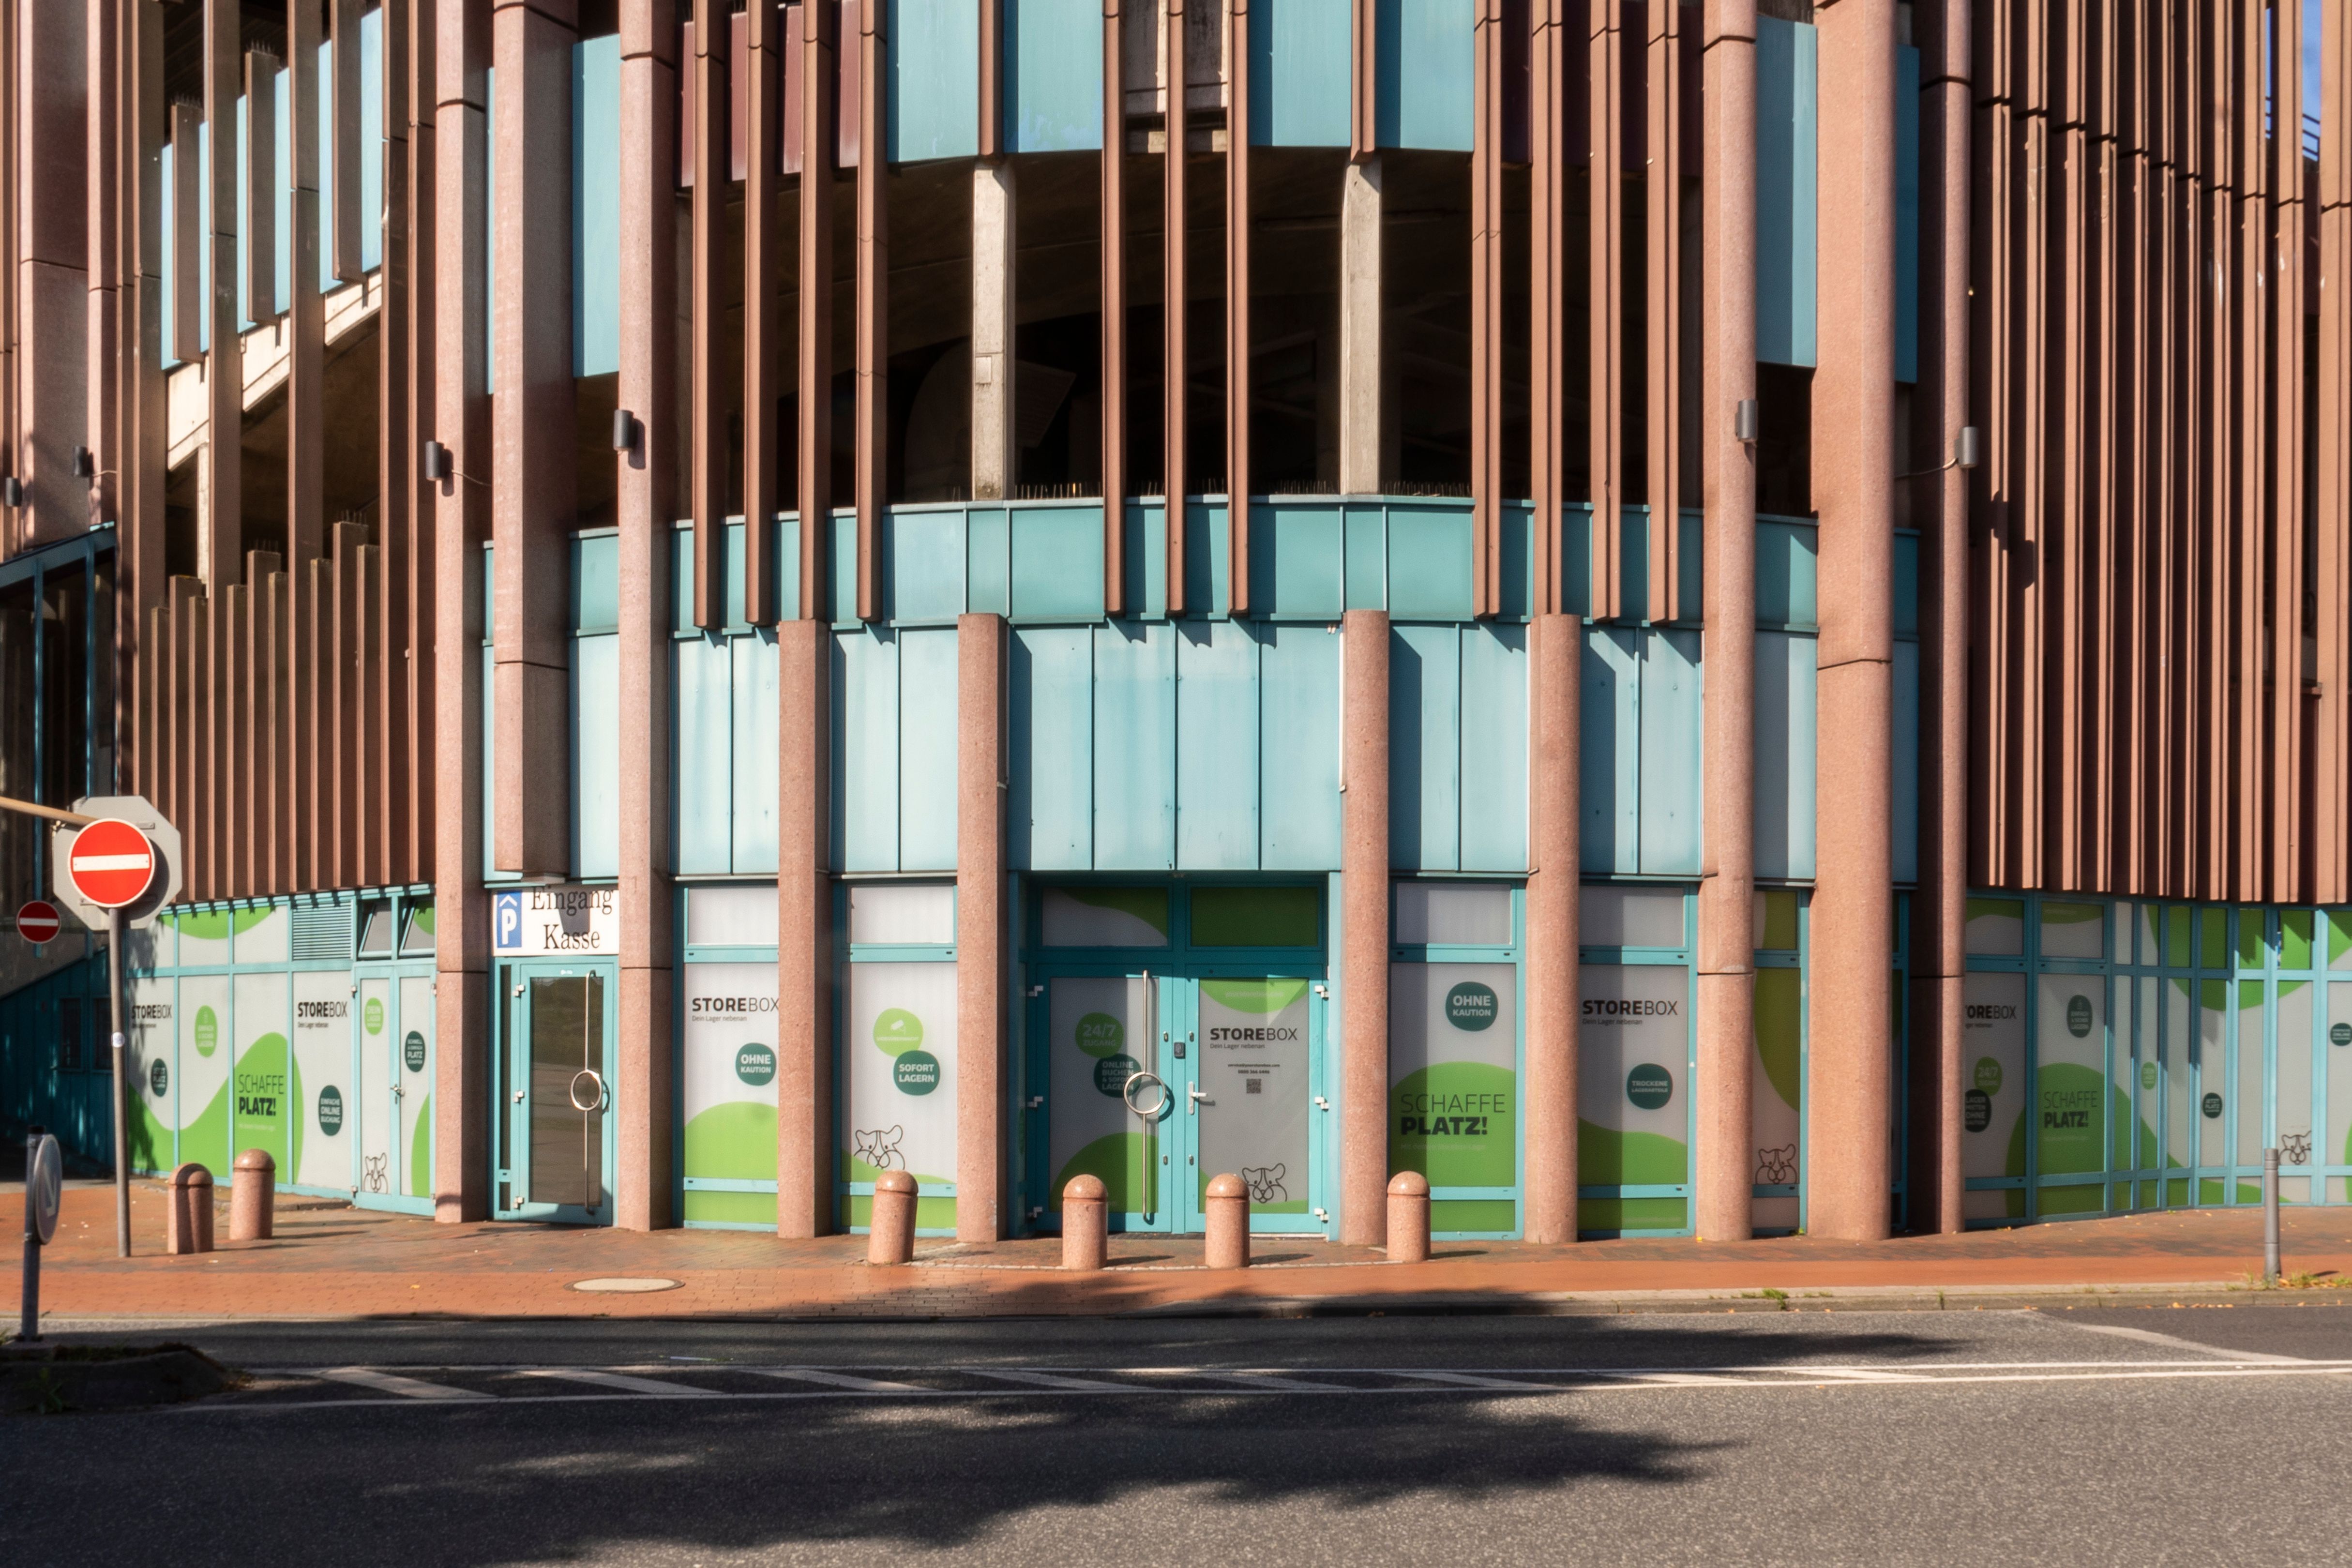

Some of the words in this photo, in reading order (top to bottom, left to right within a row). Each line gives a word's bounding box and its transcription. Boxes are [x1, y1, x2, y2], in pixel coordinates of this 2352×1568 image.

[531, 887, 613, 916] Eingang
[502, 908, 517, 945] P
[543, 924, 600, 949] Kasse
[692, 997, 779, 1012] STOREBOX
[1453, 995, 1491, 1006] OHNE
[1583, 1000, 1677, 1015] STOREBOX
[132, 1004, 172, 1019] STOREBOX
[297, 1001, 347, 1017] STOREBOX
[1965, 1005, 2017, 1019] OREBOX
[1082, 1023, 1116, 1038] 24/7
[1210, 1027, 1298, 1040] STOREBOX
[740, 1054, 771, 1064] OHNE
[899, 1063, 935, 1072] SOFORT
[239, 1074, 285, 1095] SCHAFFE
[899, 1074, 935, 1083] LAGERN
[239, 1096, 276, 1116] PLATZ!
[1401, 1094, 1506, 1113] SCHAFFE
[2044, 1091, 2097, 1109] SCHAFFE
[1401, 1116, 1488, 1135] PLATZ!
[2044, 1111, 2089, 1129] PLATZ!
